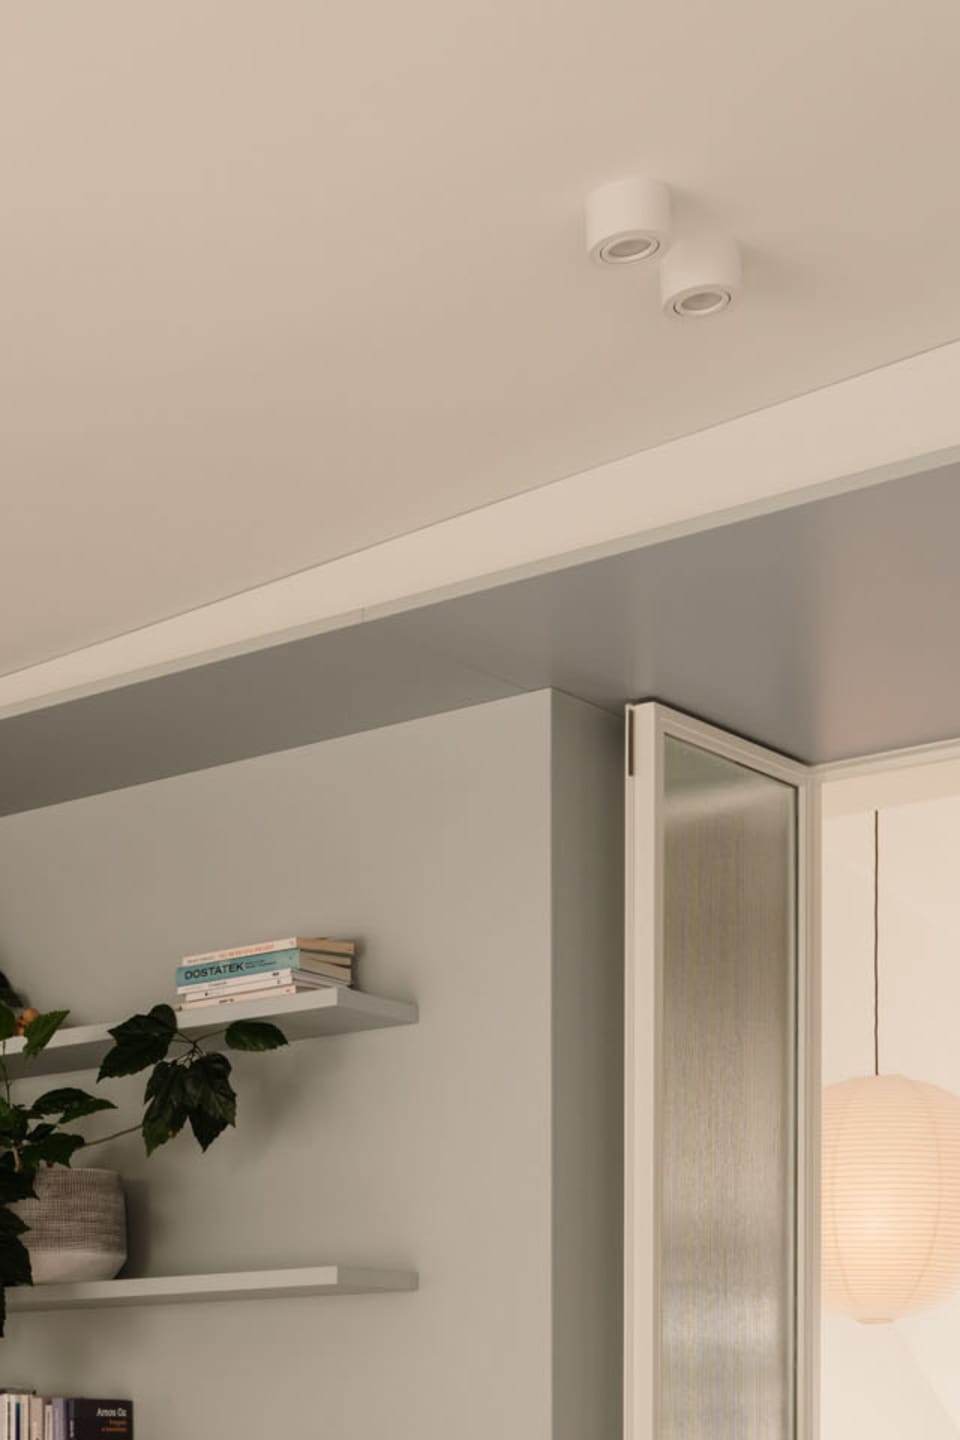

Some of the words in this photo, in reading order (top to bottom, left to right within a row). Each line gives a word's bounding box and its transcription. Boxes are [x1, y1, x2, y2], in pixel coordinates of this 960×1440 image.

[184, 961, 244, 980] DOSTATEK
[97, 1407, 116, 1417] Amos
[117, 1407, 127, 1417] Oz
